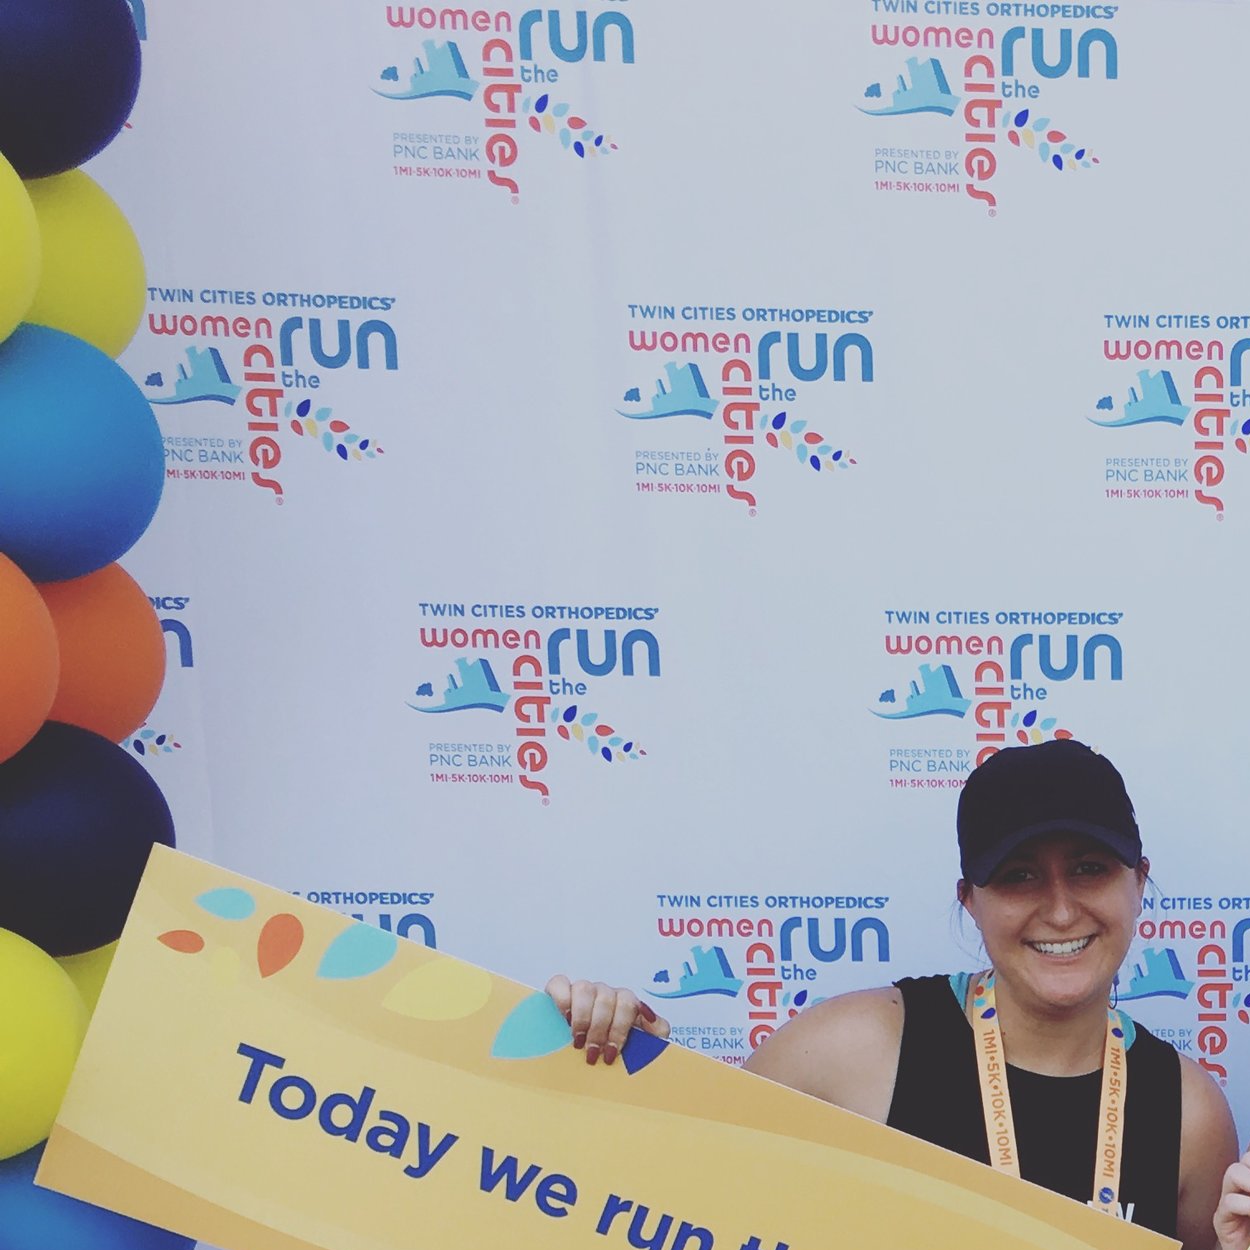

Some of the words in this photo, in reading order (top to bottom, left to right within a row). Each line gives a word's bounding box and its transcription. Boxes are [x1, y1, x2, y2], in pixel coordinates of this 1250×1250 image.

[384, 6, 511, 33] women
[518, 8, 635, 64] run
[869, 24, 994, 49] women
[1001, 26, 1118, 79] run
[521, 64, 559, 84] the
[1001, 80, 1040, 99] the
[481, 37, 523, 195] cities
[962, 53, 1004, 206] cities
[147, 313, 272, 339] women
[279, 316, 398, 371] run
[627, 330, 751, 354] women
[758, 331, 874, 382] run
[1102, 338, 1223, 361] women
[281, 369, 320, 388] the
[759, 383, 796, 402] the
[242, 343, 285, 494] cities
[720, 358, 762, 506] cities
[1192, 365, 1232, 511] cities
[418, 602, 464, 616] TWIN
[471, 604, 525, 618] CITIES
[418, 627, 541, 649] women
[548, 627, 661, 676] run
[884, 634, 1003, 656] women
[1010, 634, 1122, 681] run
[549, 678, 586, 696] the
[1010, 683, 1047, 700] the
[511, 654, 552, 796] cities
[656, 917, 773, 938] women
[781, 916, 889, 963] run
[782, 964, 817, 980] the
[1197, 944, 1235, 1076] cities
[239, 1044, 456, 1178] Today
[481, 1148, 577, 1217] we
